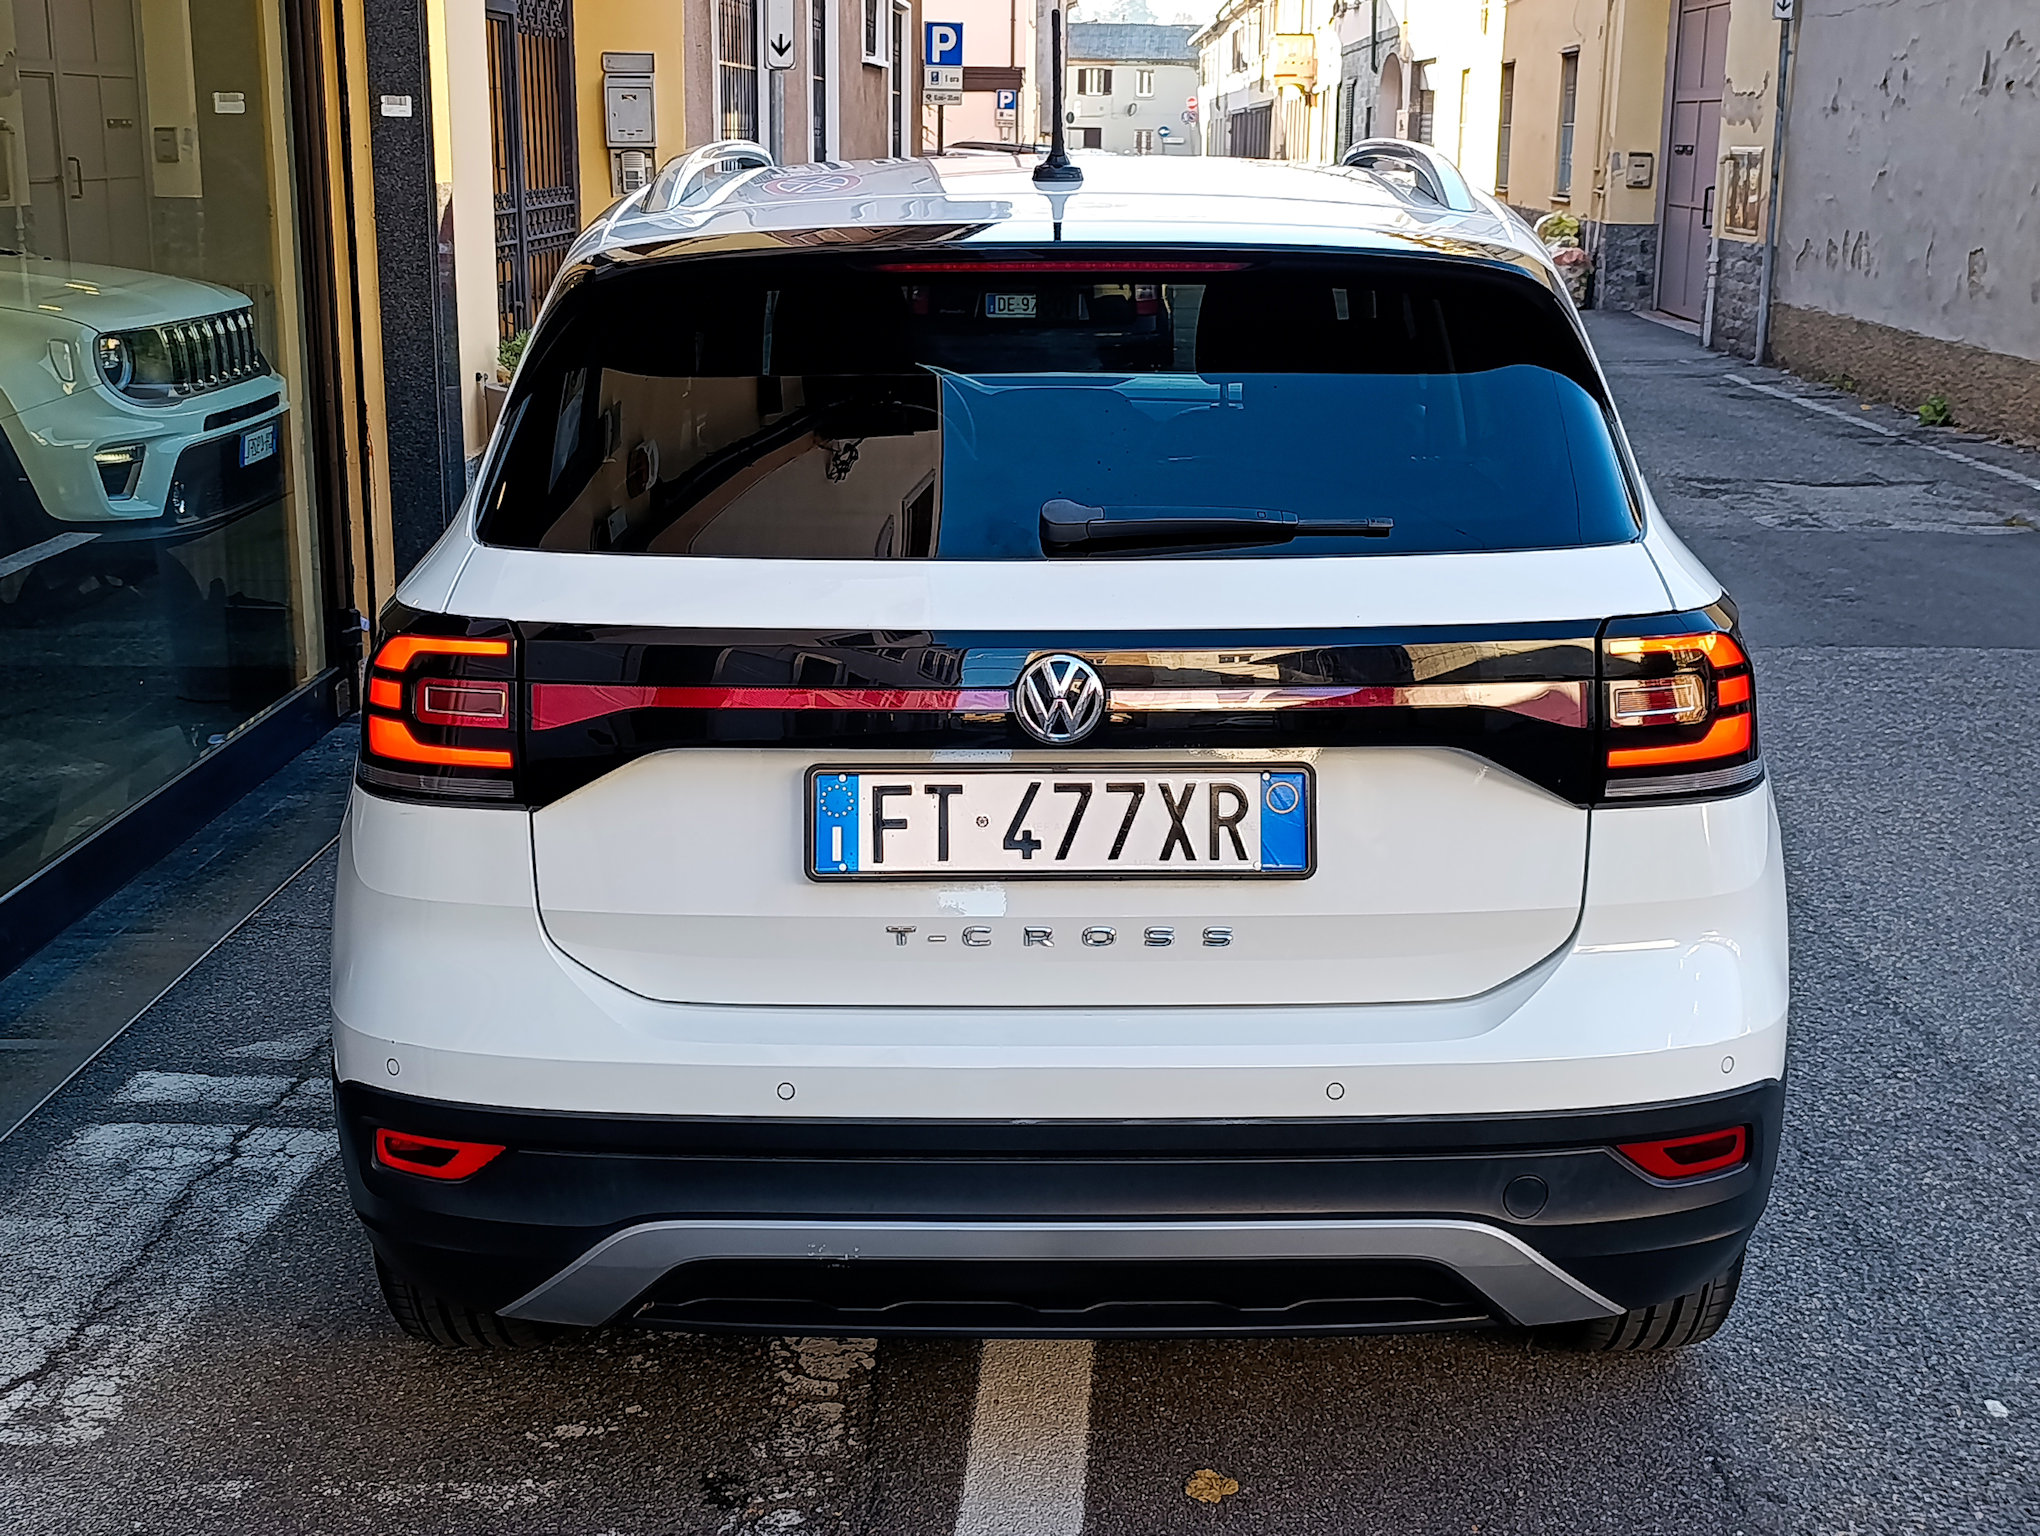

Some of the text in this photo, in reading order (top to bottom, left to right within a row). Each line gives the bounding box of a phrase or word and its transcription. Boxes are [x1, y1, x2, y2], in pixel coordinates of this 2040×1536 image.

[932, 25, 957, 63] P
[999, 91, 1013, 109] P
[998, 297, 1015, 312] DE
[832, 782, 1249, 863] I FT 477XR
[885, 925, 1234, 947] T-CROSS
